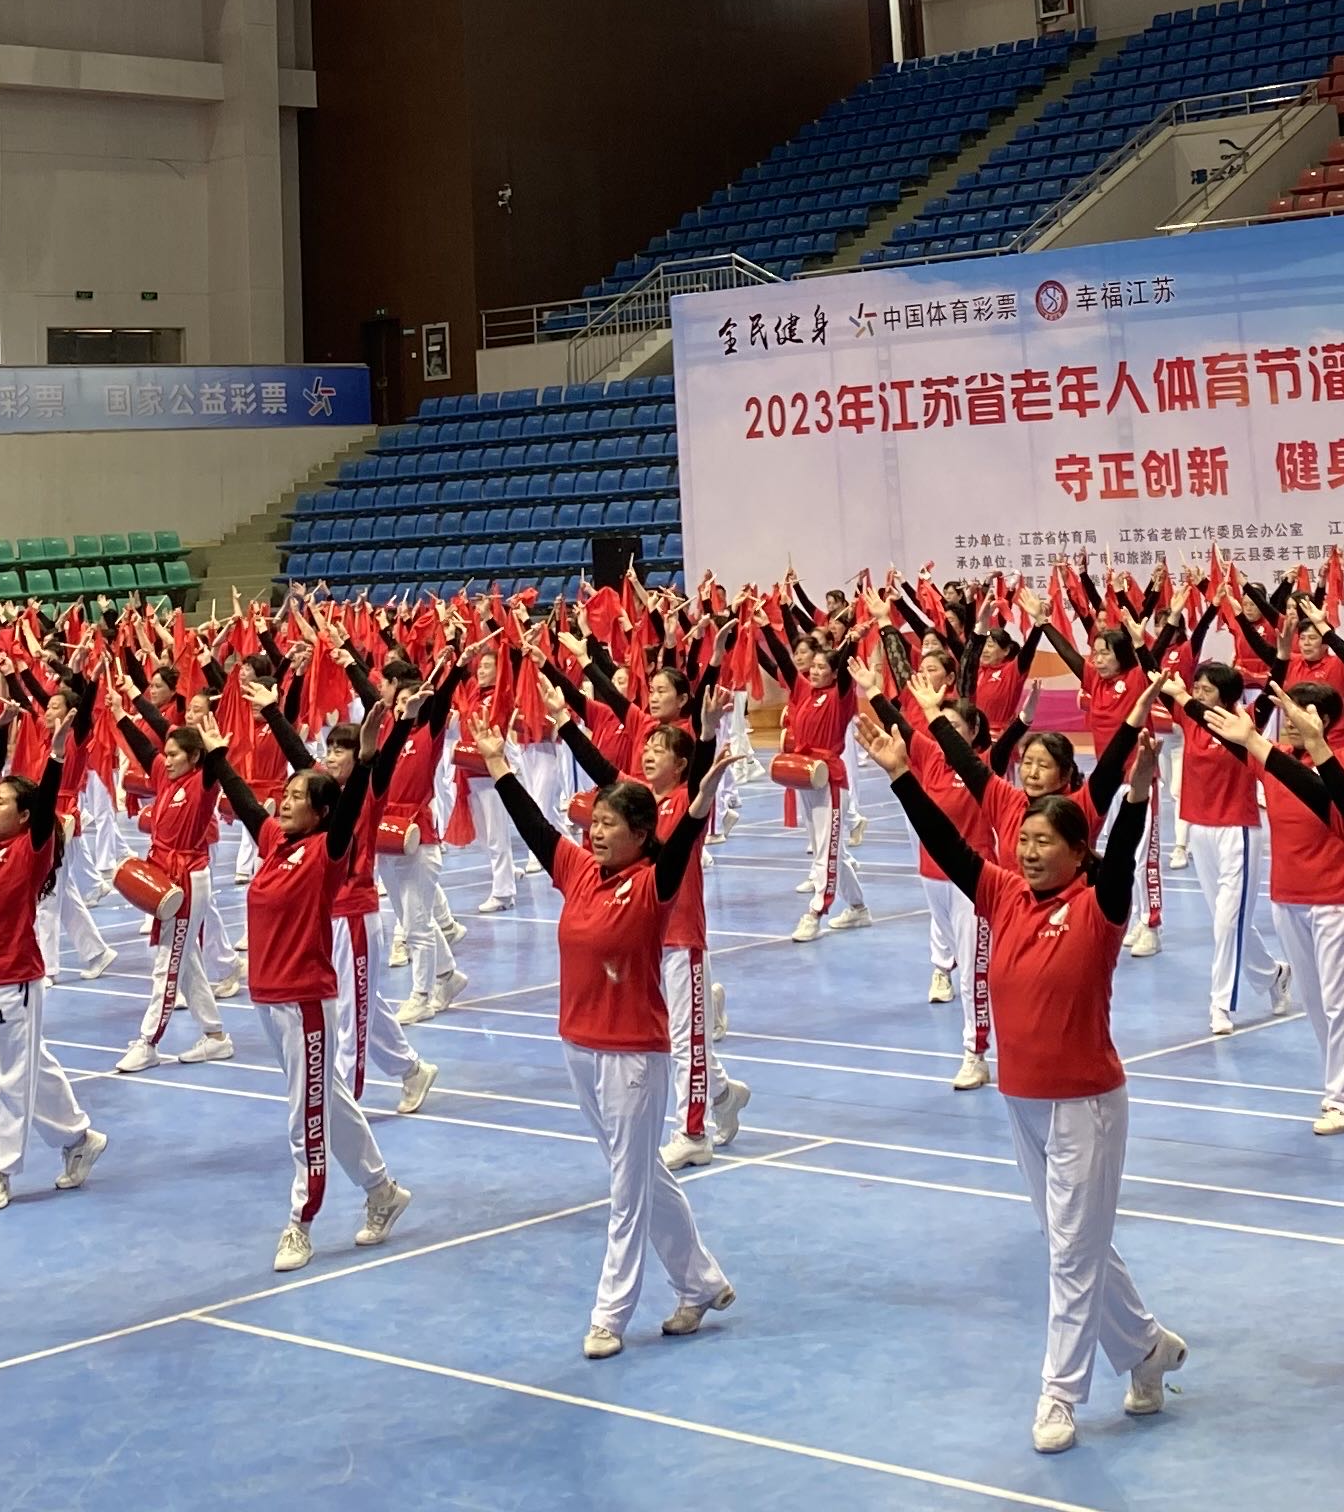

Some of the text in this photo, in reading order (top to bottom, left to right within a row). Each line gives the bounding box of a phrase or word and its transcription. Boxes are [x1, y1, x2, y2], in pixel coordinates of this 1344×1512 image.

[883, 292, 1018, 331] 中国体育彩票
[1076, 276, 1175, 312] 幸福江苏
[718, 304, 829, 355] 全民健身
[105, 381, 288, 417] 国家公益彩票
[1055, 444, 1229, 503] 守正创新
[1119, 522, 1303, 542] 江苏省老龄工作委员会办公室
[976, 1003, 989, 1028] THE
[693, 1044, 705, 1067] BU
[692, 1070, 706, 1103] THE
[307, 1114, 322, 1139] BU
[309, 1141, 325, 1177] THE
